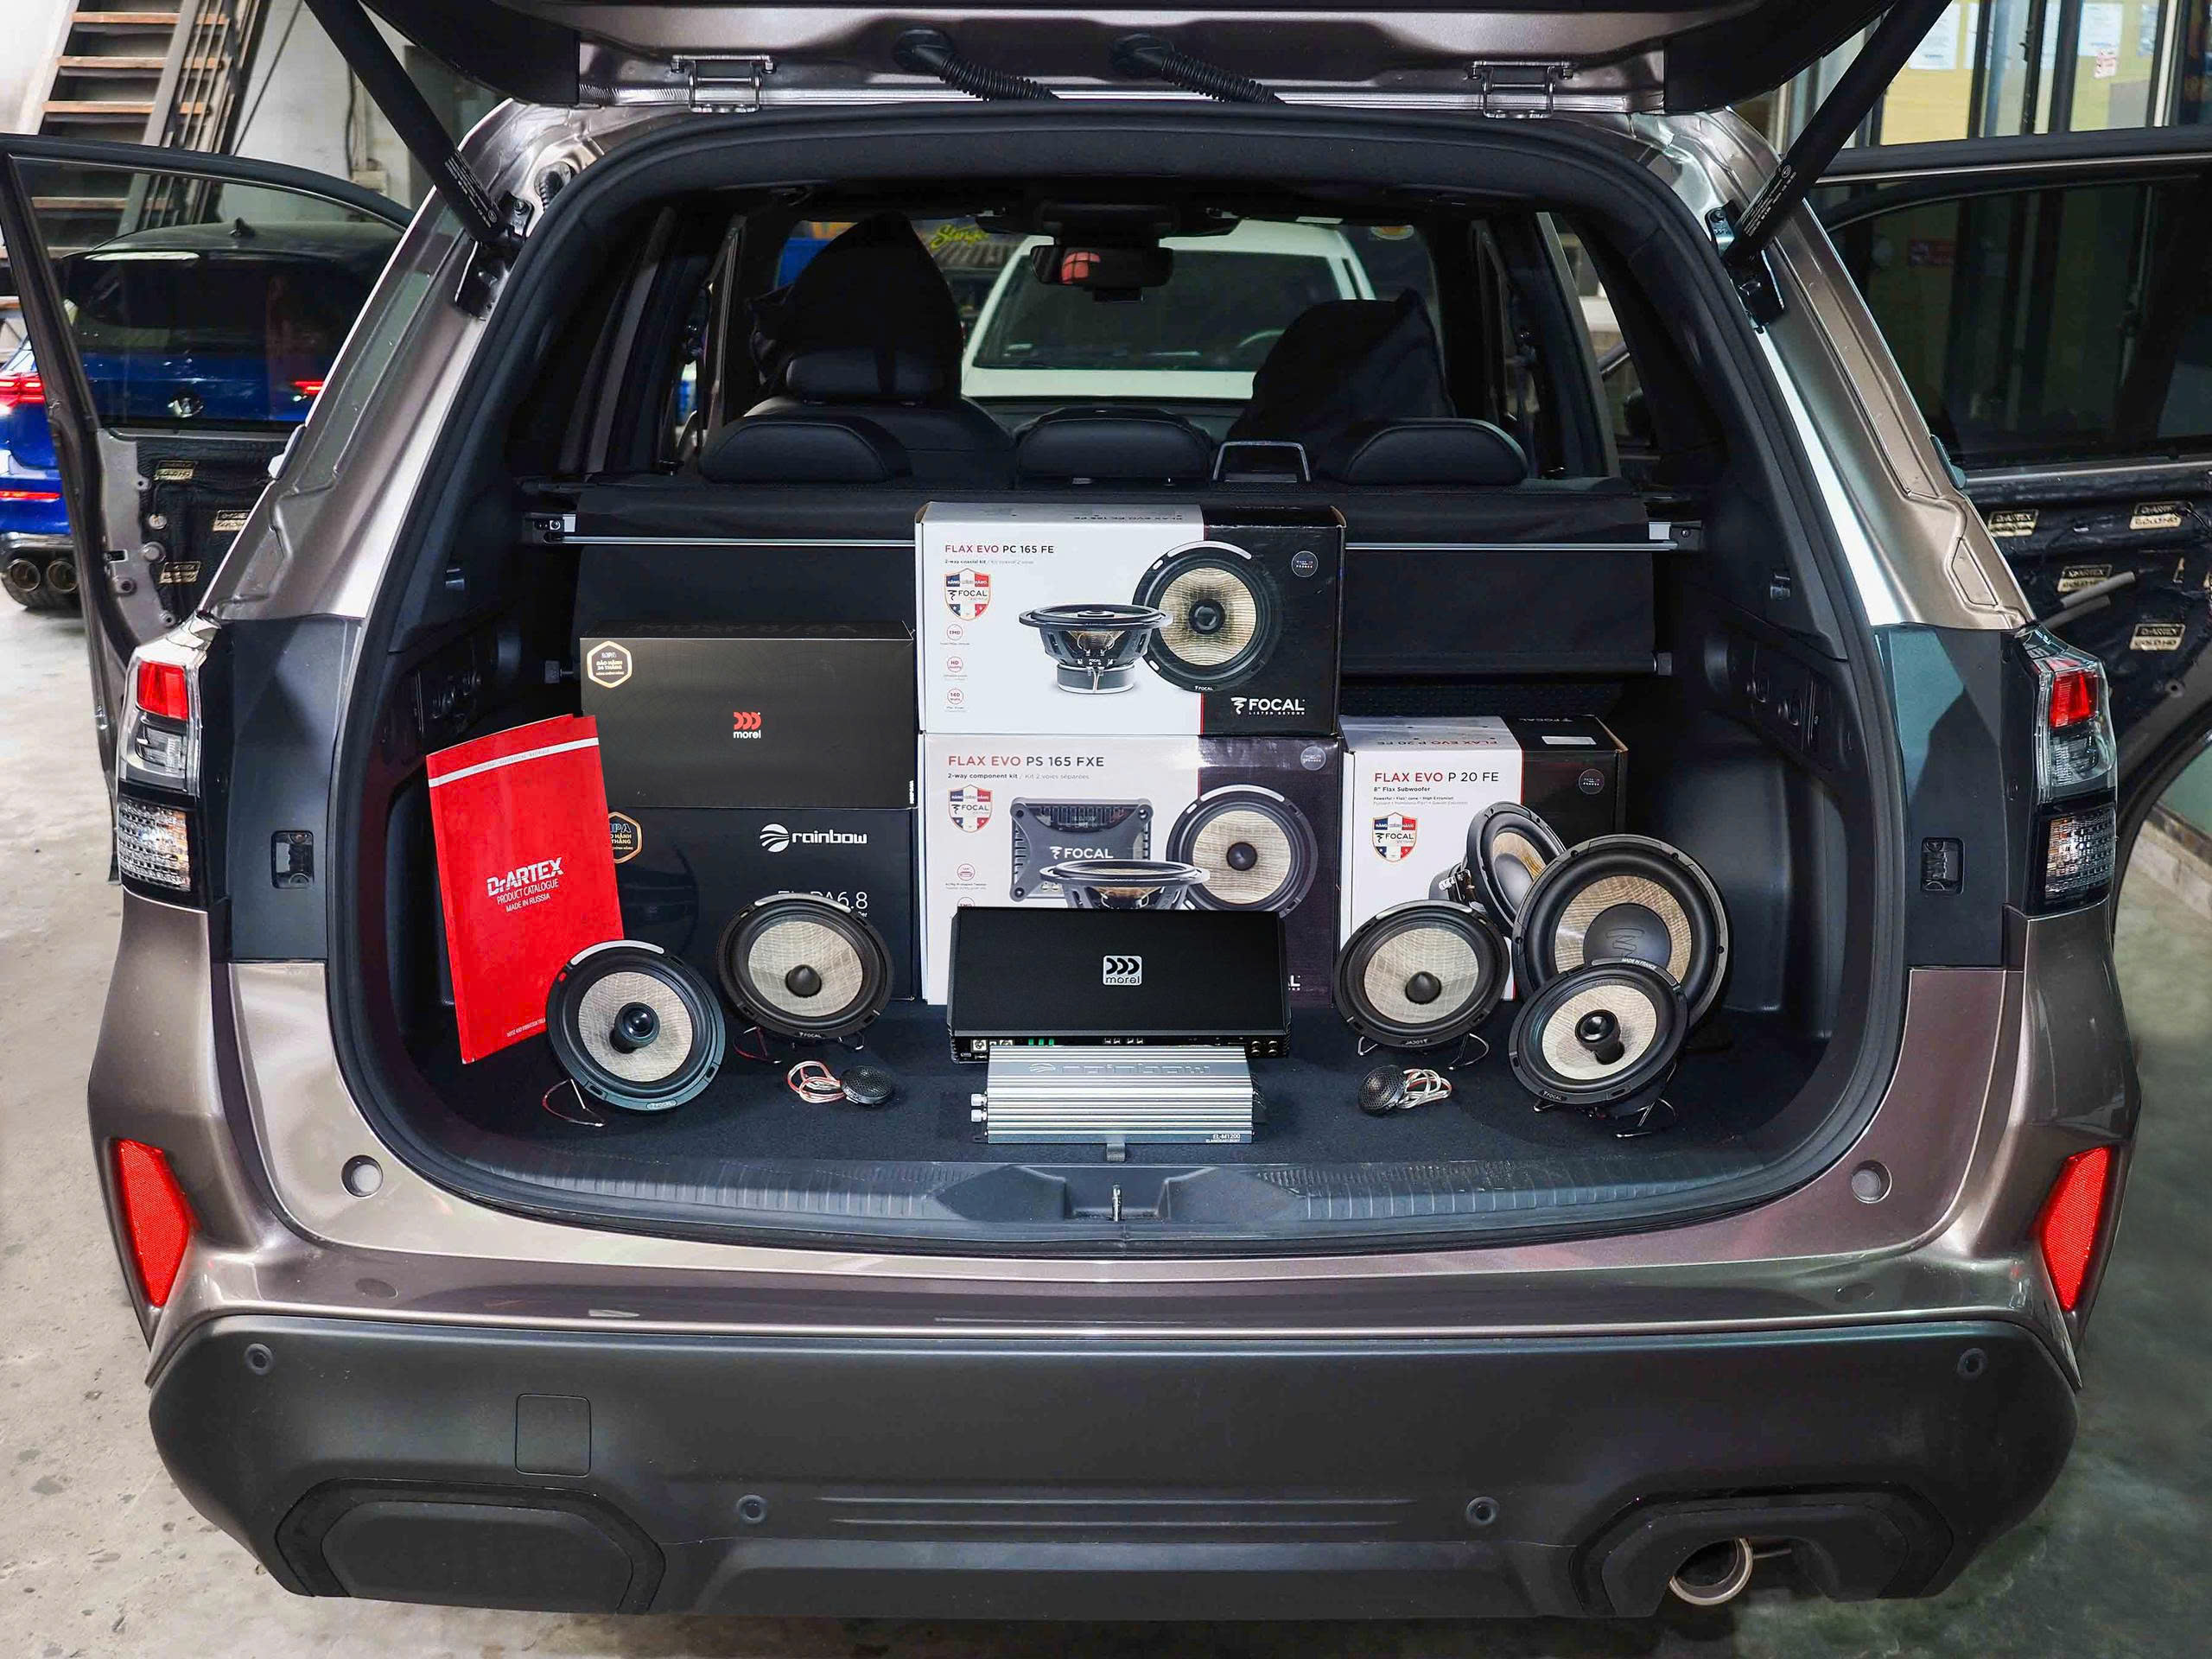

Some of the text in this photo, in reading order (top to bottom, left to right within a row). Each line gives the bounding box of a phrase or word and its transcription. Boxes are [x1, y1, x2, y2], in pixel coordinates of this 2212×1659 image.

[1249, 698, 1305, 710] FOCAL
[734, 729, 761, 739] morel
[949, 756, 1104, 766] FLAX EVO PS 165 FXE
[1375, 772, 1499, 782] FLAX EVO P 20 FE
[792, 830, 868, 844] rainbow
[1065, 848, 1114, 859] FOCAL
[486, 857, 563, 896] DrARTEX
[498, 879, 559, 905] PRODUCT CATALOGUE
[506, 900, 522, 912] MADE
[530, 893, 550, 905] RUSSIA
[1105, 976, 1141, 984] morel
